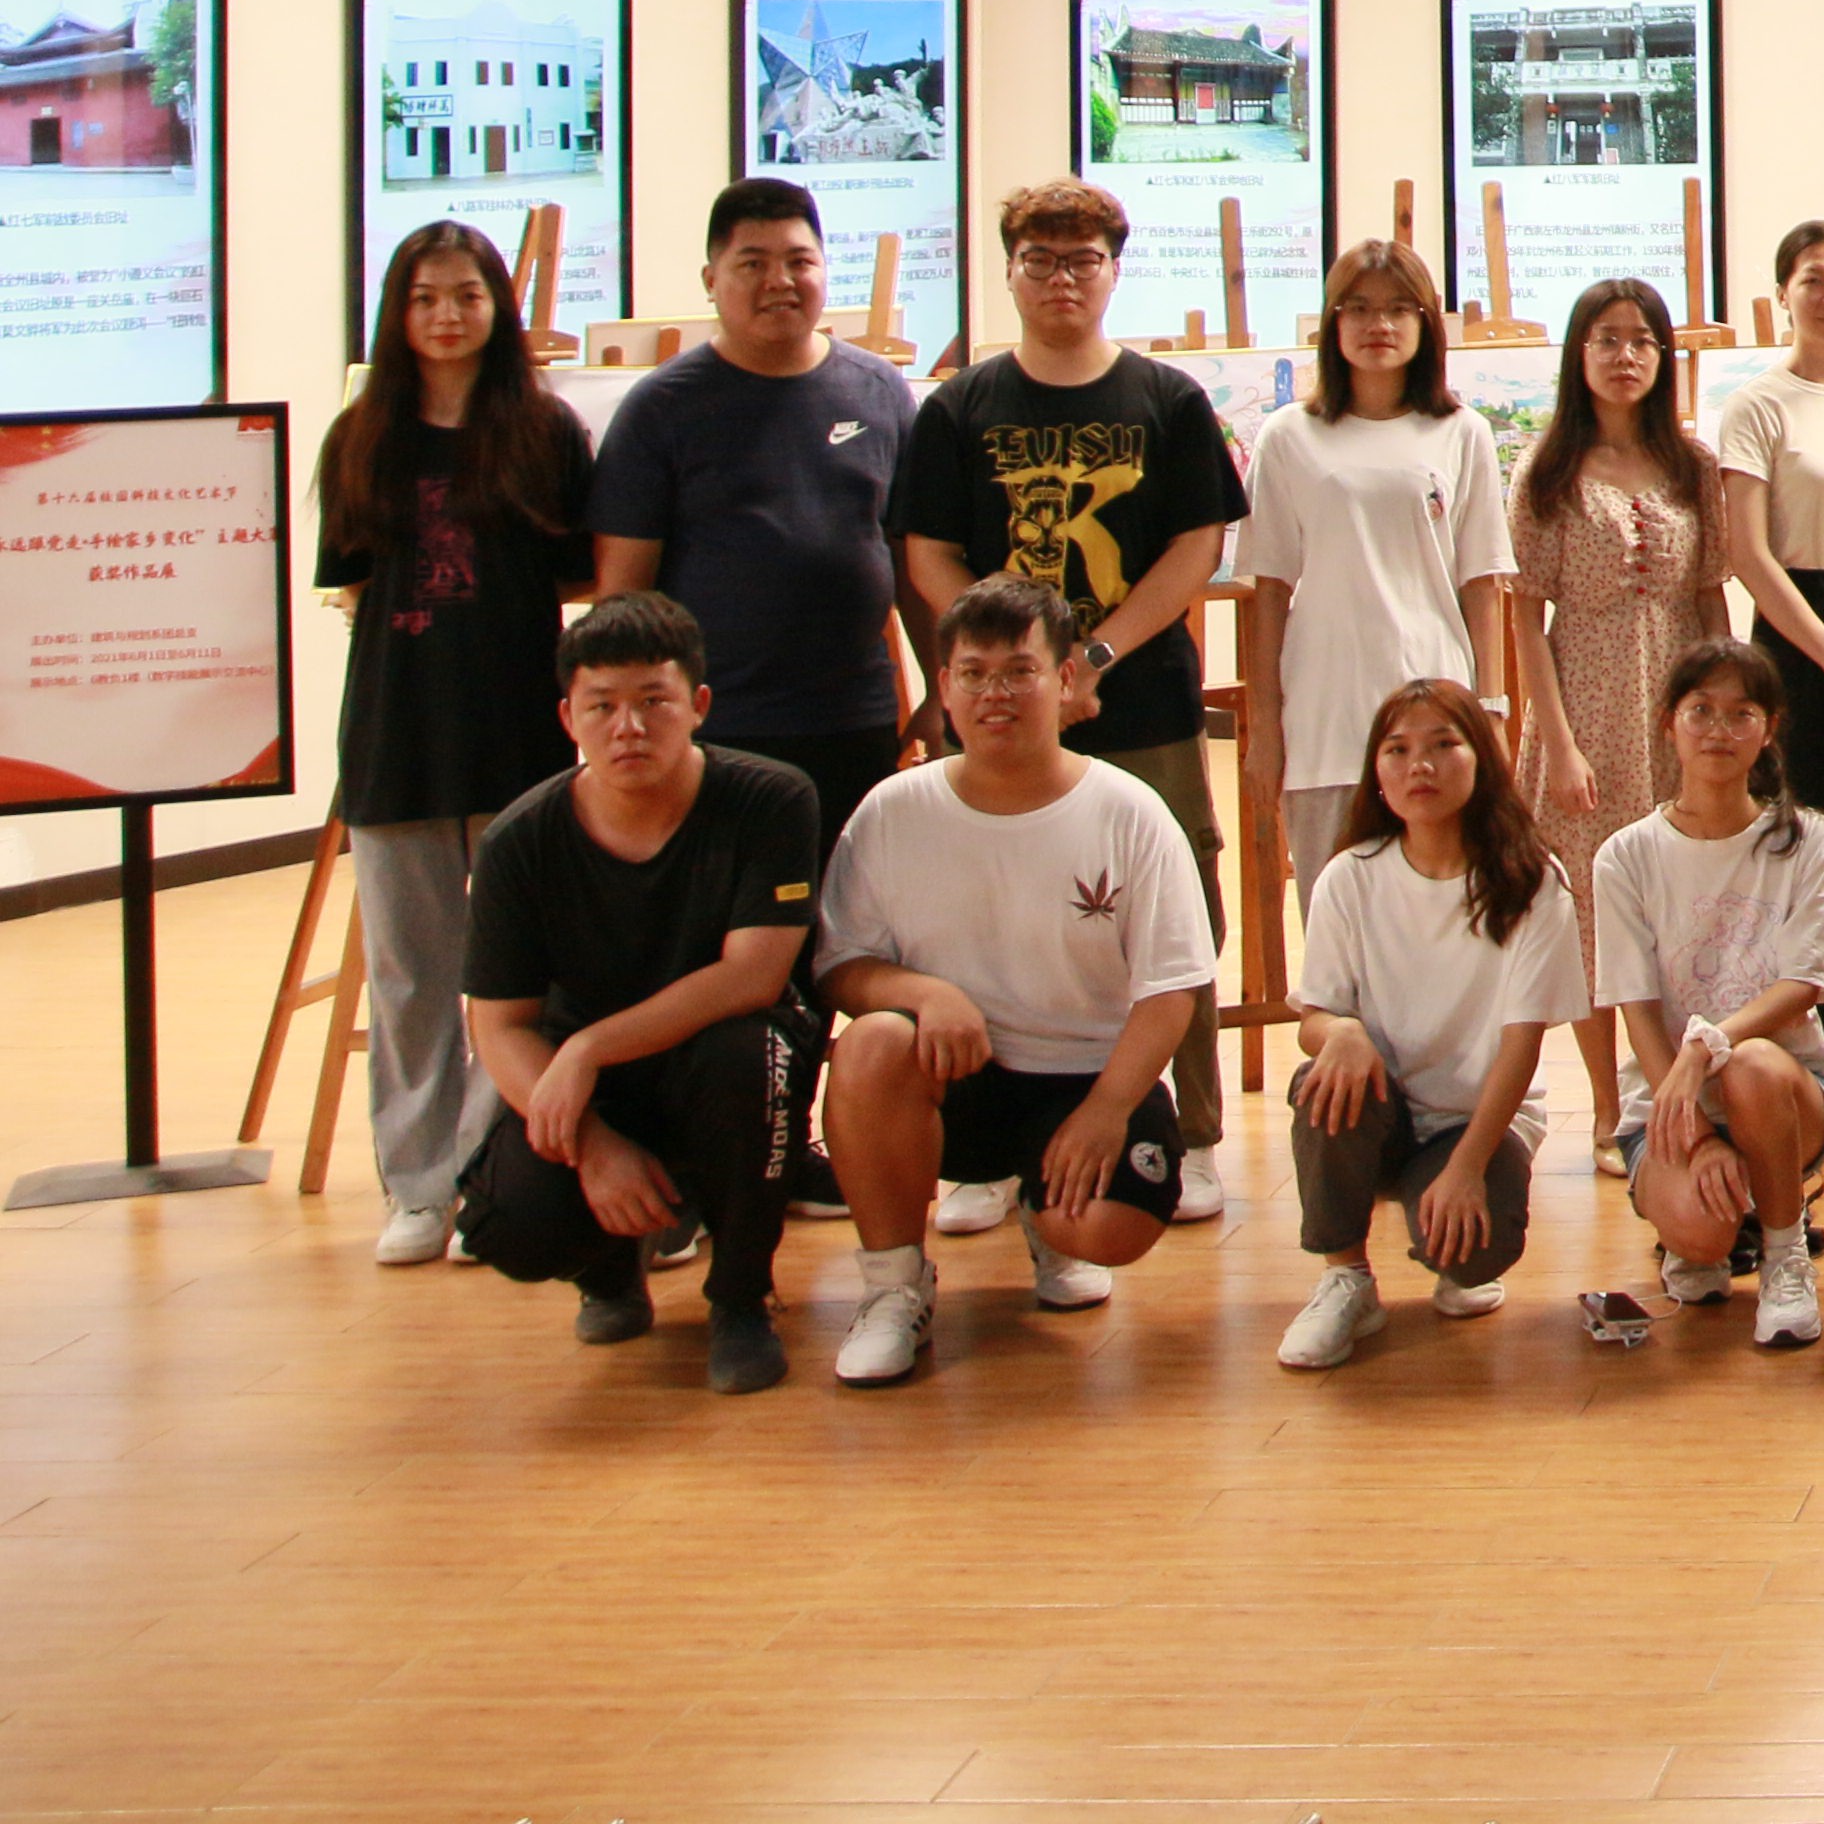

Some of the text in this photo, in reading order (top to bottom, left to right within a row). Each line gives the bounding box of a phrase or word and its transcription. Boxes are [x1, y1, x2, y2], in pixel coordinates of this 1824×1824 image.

[89, 560, 177, 582] 获奖作品展
